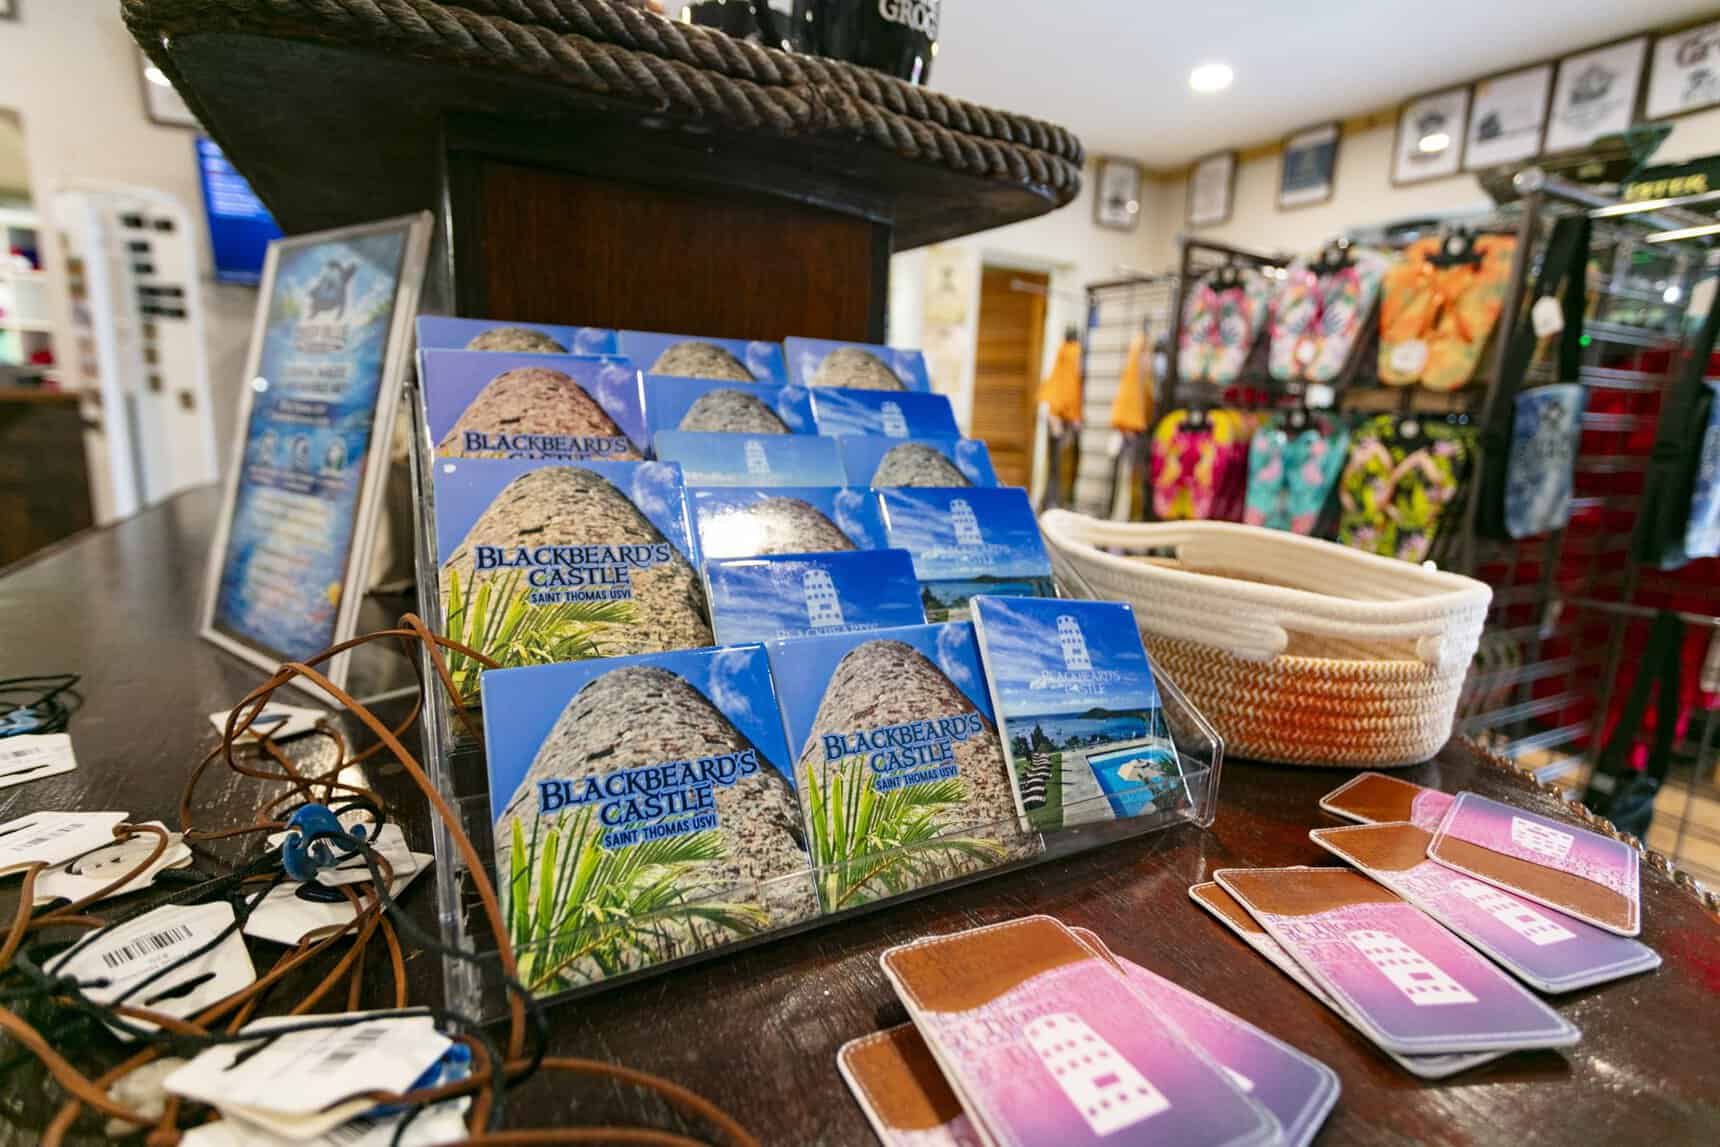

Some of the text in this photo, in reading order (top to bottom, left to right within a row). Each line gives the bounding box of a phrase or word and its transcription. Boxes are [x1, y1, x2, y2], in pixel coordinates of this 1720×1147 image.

[464, 432, 627, 457] BLACKBEARD'S
[475, 545, 670, 569] BLACKBEARD'S
[528, 567, 630, 587] CASTLE
[531, 589, 631, 603] SAINT THOMAS USVI
[823, 714, 983, 761] BLACKBEARD'S
[870, 741, 954, 773] CASTLE
[539, 751, 759, 813] BLACKBEARD'S
[876, 766, 958, 791] SAINT THOMAS USVI
[601, 784, 715, 827] CASTLE
[605, 814, 717, 848] SAINT THOMAS USVI
